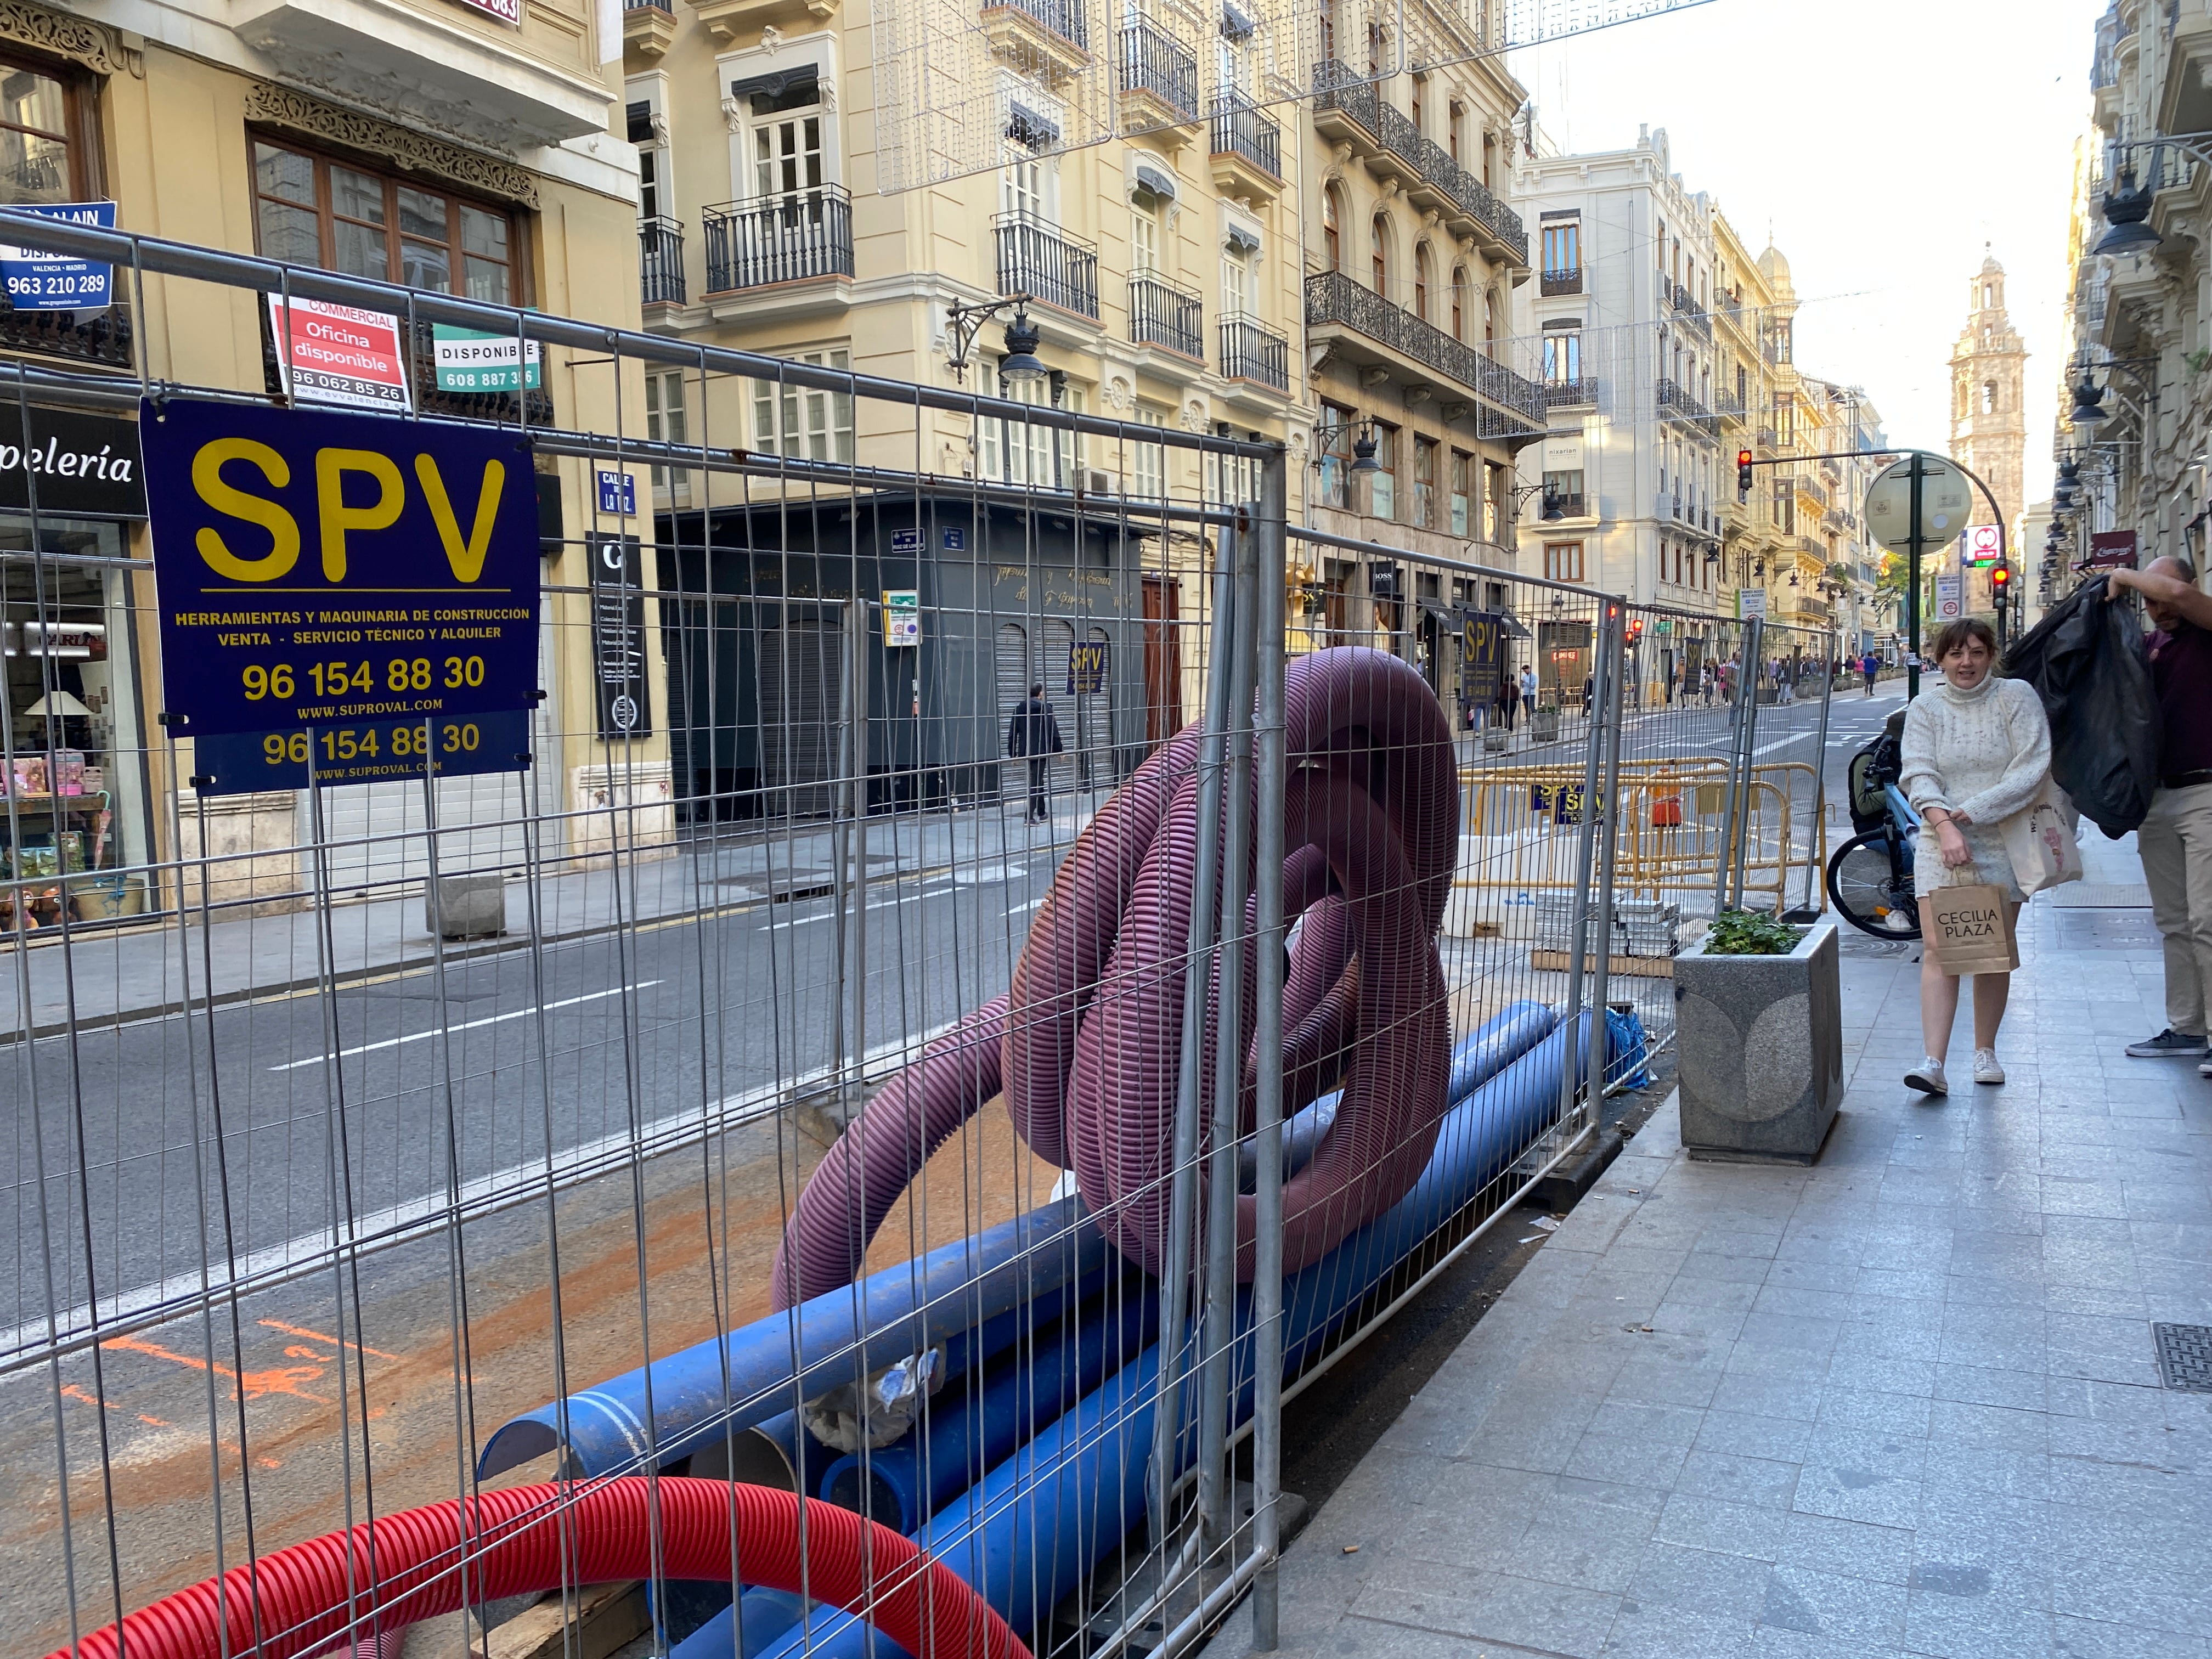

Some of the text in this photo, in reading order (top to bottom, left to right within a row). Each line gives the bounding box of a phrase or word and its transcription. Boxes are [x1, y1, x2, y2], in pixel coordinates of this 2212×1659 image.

[8, 274, 105, 294] 963 210 289
[309, 300, 394, 329] COMMERCIAL
[306, 321, 370, 348] Oficina
[295, 342, 388, 373] disponible
[442, 344, 533, 359] DISPONIBE
[293, 370, 400, 399] 96 062 85 26
[447, 370, 532, 386] 608 887 36
[602, 473, 630, 487] CALE
[191, 437, 506, 584] SPV
[605, 494, 614, 510] LA
[176, 606, 529, 626] HERRAMIENTAS Y MAQUINARIA DE CONSTRUCCIÓN
[217, 633, 271, 646] VENTA
[293, 629, 362, 644] SERVICIO
[365, 627, 425, 642] TÉCNICO
[428, 628, 439, 641] Y
[440, 626, 501, 640] ALQUILER
[1465, 620, 1497, 663] SPV
[1071, 647, 1102, 670] SPV
[242, 655, 485, 701] 96 154 88 30
[297, 698, 443, 720] WWW.SUPROVAL.COM
[263, 723, 481, 765] 96 154 88 30
[1938, 909, 1998, 925] CECILIA
[1945, 923, 1995, 938] PLAZA
